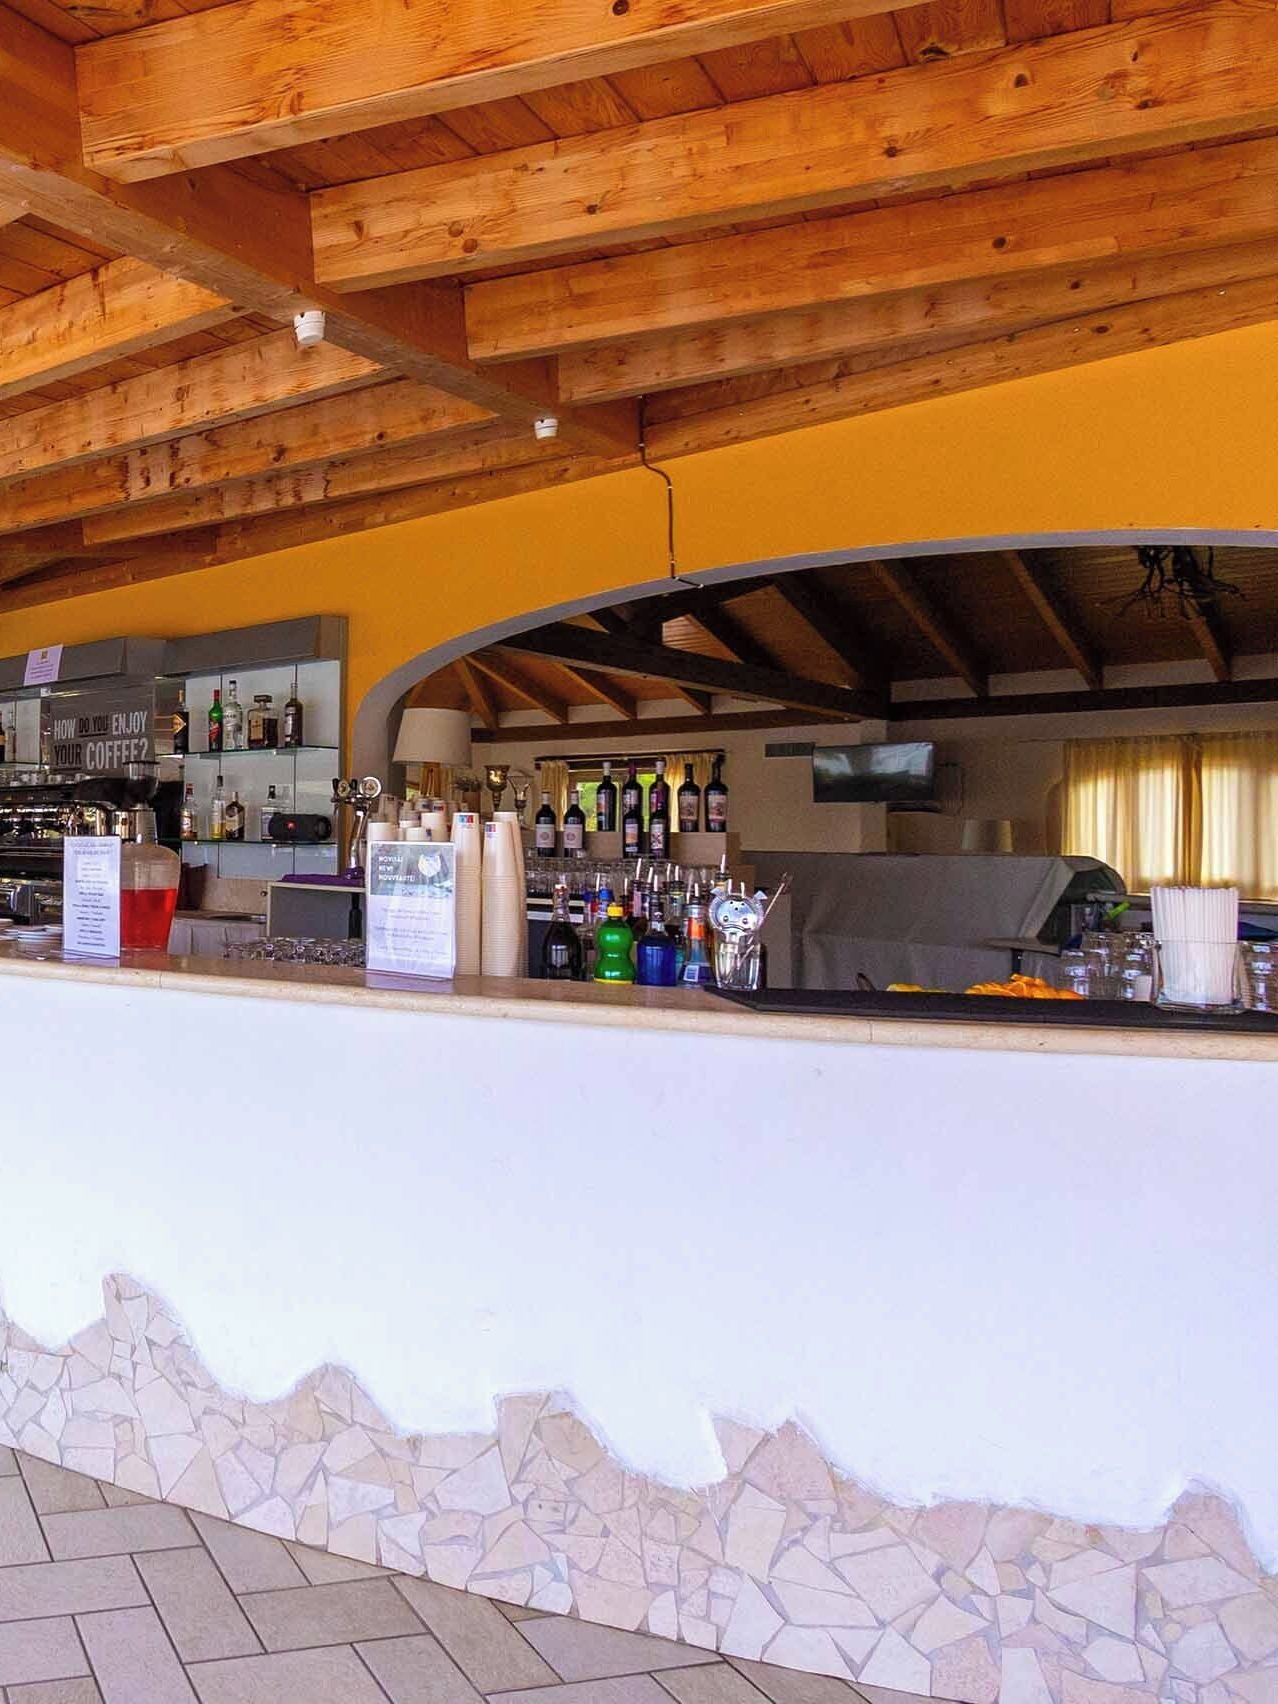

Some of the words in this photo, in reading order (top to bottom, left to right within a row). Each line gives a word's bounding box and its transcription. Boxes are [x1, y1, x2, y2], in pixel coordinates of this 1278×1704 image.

[54, 718, 76, 740] HOW
[79, 717, 90, 733] DO
[92, 715, 108, 732] YOU
[112, 711, 147, 736] ENJOY
[54, 743, 82, 766] YOUR
[86, 737, 148, 770] COFFEE?
